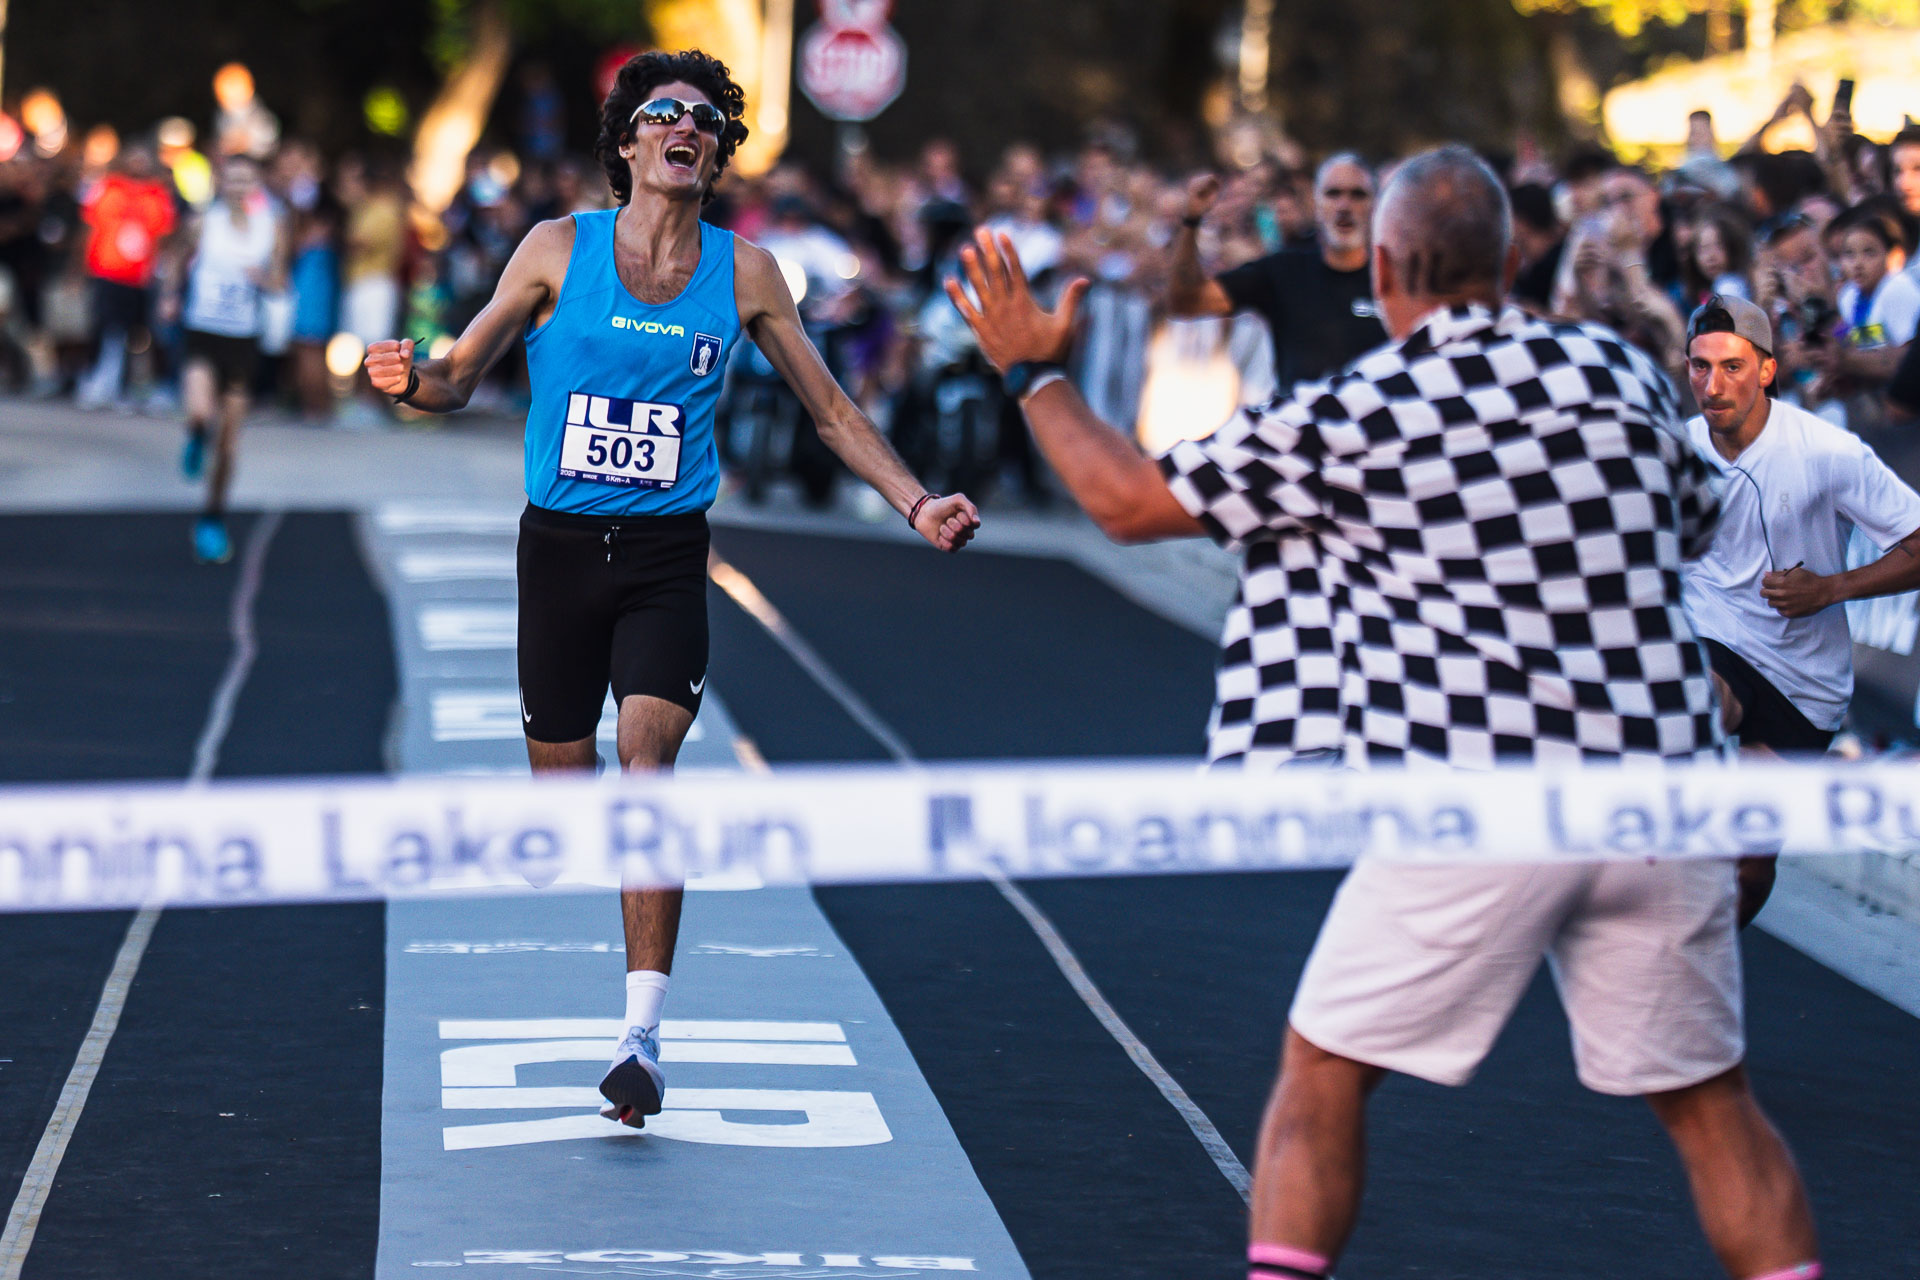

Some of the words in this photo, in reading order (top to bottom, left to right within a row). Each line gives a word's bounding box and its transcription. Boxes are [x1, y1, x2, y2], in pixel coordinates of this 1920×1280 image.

[611, 316, 685, 337] GIVOVA
[566, 393, 681, 436] ILR
[560, 469, 576, 477] 2025
[586, 433, 656, 472] 503
[1543, 784, 1784, 856] Lake
[320, 804, 562, 890] Lake
[606, 798, 812, 884] Run
